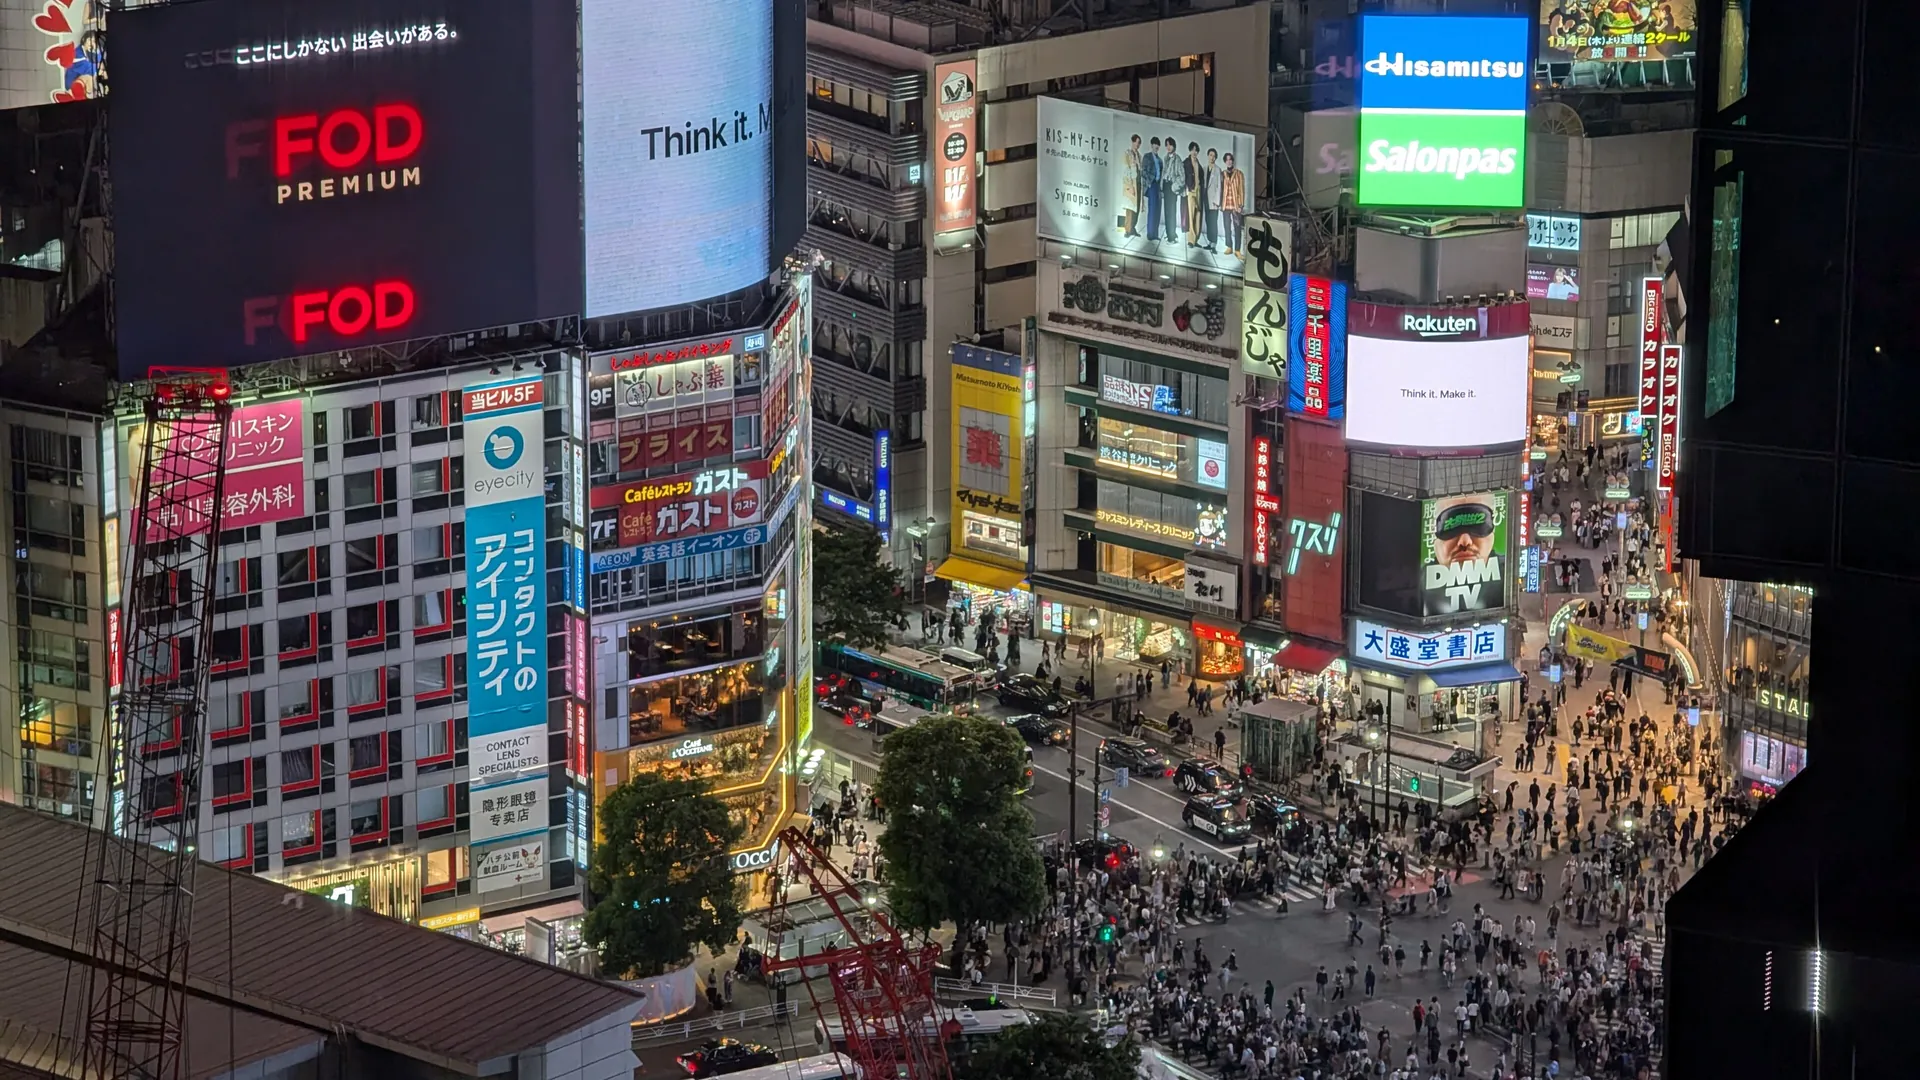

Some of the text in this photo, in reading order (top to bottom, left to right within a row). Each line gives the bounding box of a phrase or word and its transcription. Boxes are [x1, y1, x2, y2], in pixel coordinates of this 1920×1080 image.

[234, 23, 458, 66] ここにしかない 出会いがある。
[1365, 52, 1524, 78] Hisamitsu
[275, 104, 423, 177] FOD
[641, 120, 727, 160] Think
[734, 110, 753, 144] it.
[1365, 139, 1518, 180] Salonpas
[277, 167, 422, 204] PREMIUM
[1055, 188, 1099, 207] Synopsis
[1537, 218, 1578, 233] れいわ
[294, 281, 415, 343] FOD
[1246, 220, 1288, 377] もんじゃ
[1404, 314, 1476, 332] Rakuten
[656, 365, 725, 397] しゃぶ葉
[956, 373, 996, 390] Matsumoto
[1642, 339, 1657, 408] カラオケ
[471, 385, 535, 410] 当ビル5F
[590, 387, 612, 406] 9F
[1401, 389, 1476, 399] Think it. Make it.
[1663, 355, 1678, 426] カラオケ
[619, 423, 728, 464] プライス
[474, 471, 534, 495] eyecity
[695, 468, 748, 496] ガスト
[656, 500, 722, 536] ガスト
[734, 499, 756, 511] ガスト
[1493, 494, 1506, 526] 再び
[591, 518, 617, 540] 7F
[623, 512, 652, 529] Café
[1423, 503, 1436, 564] 脱出せよ
[598, 530, 759, 568] AEON 英会話イーオン 6F
[1288, 512, 1342, 575] クスリ
[1425, 557, 1501, 591] DMM
[513, 528, 537, 691] コンタクトの
[1445, 584, 1481, 610] TV
[475, 533, 509, 696] アイシティ
[1364, 630, 1495, 660] 大盛堂書店
[487, 736, 530, 752] CONTACT
[497, 749, 520, 762] LENS
[478, 756, 539, 775] SPECIALISTS
[482, 791, 537, 813] 隐形眼镜
[489, 808, 529, 827] 专卖店
[487, 851, 519, 865] ハチ公前
